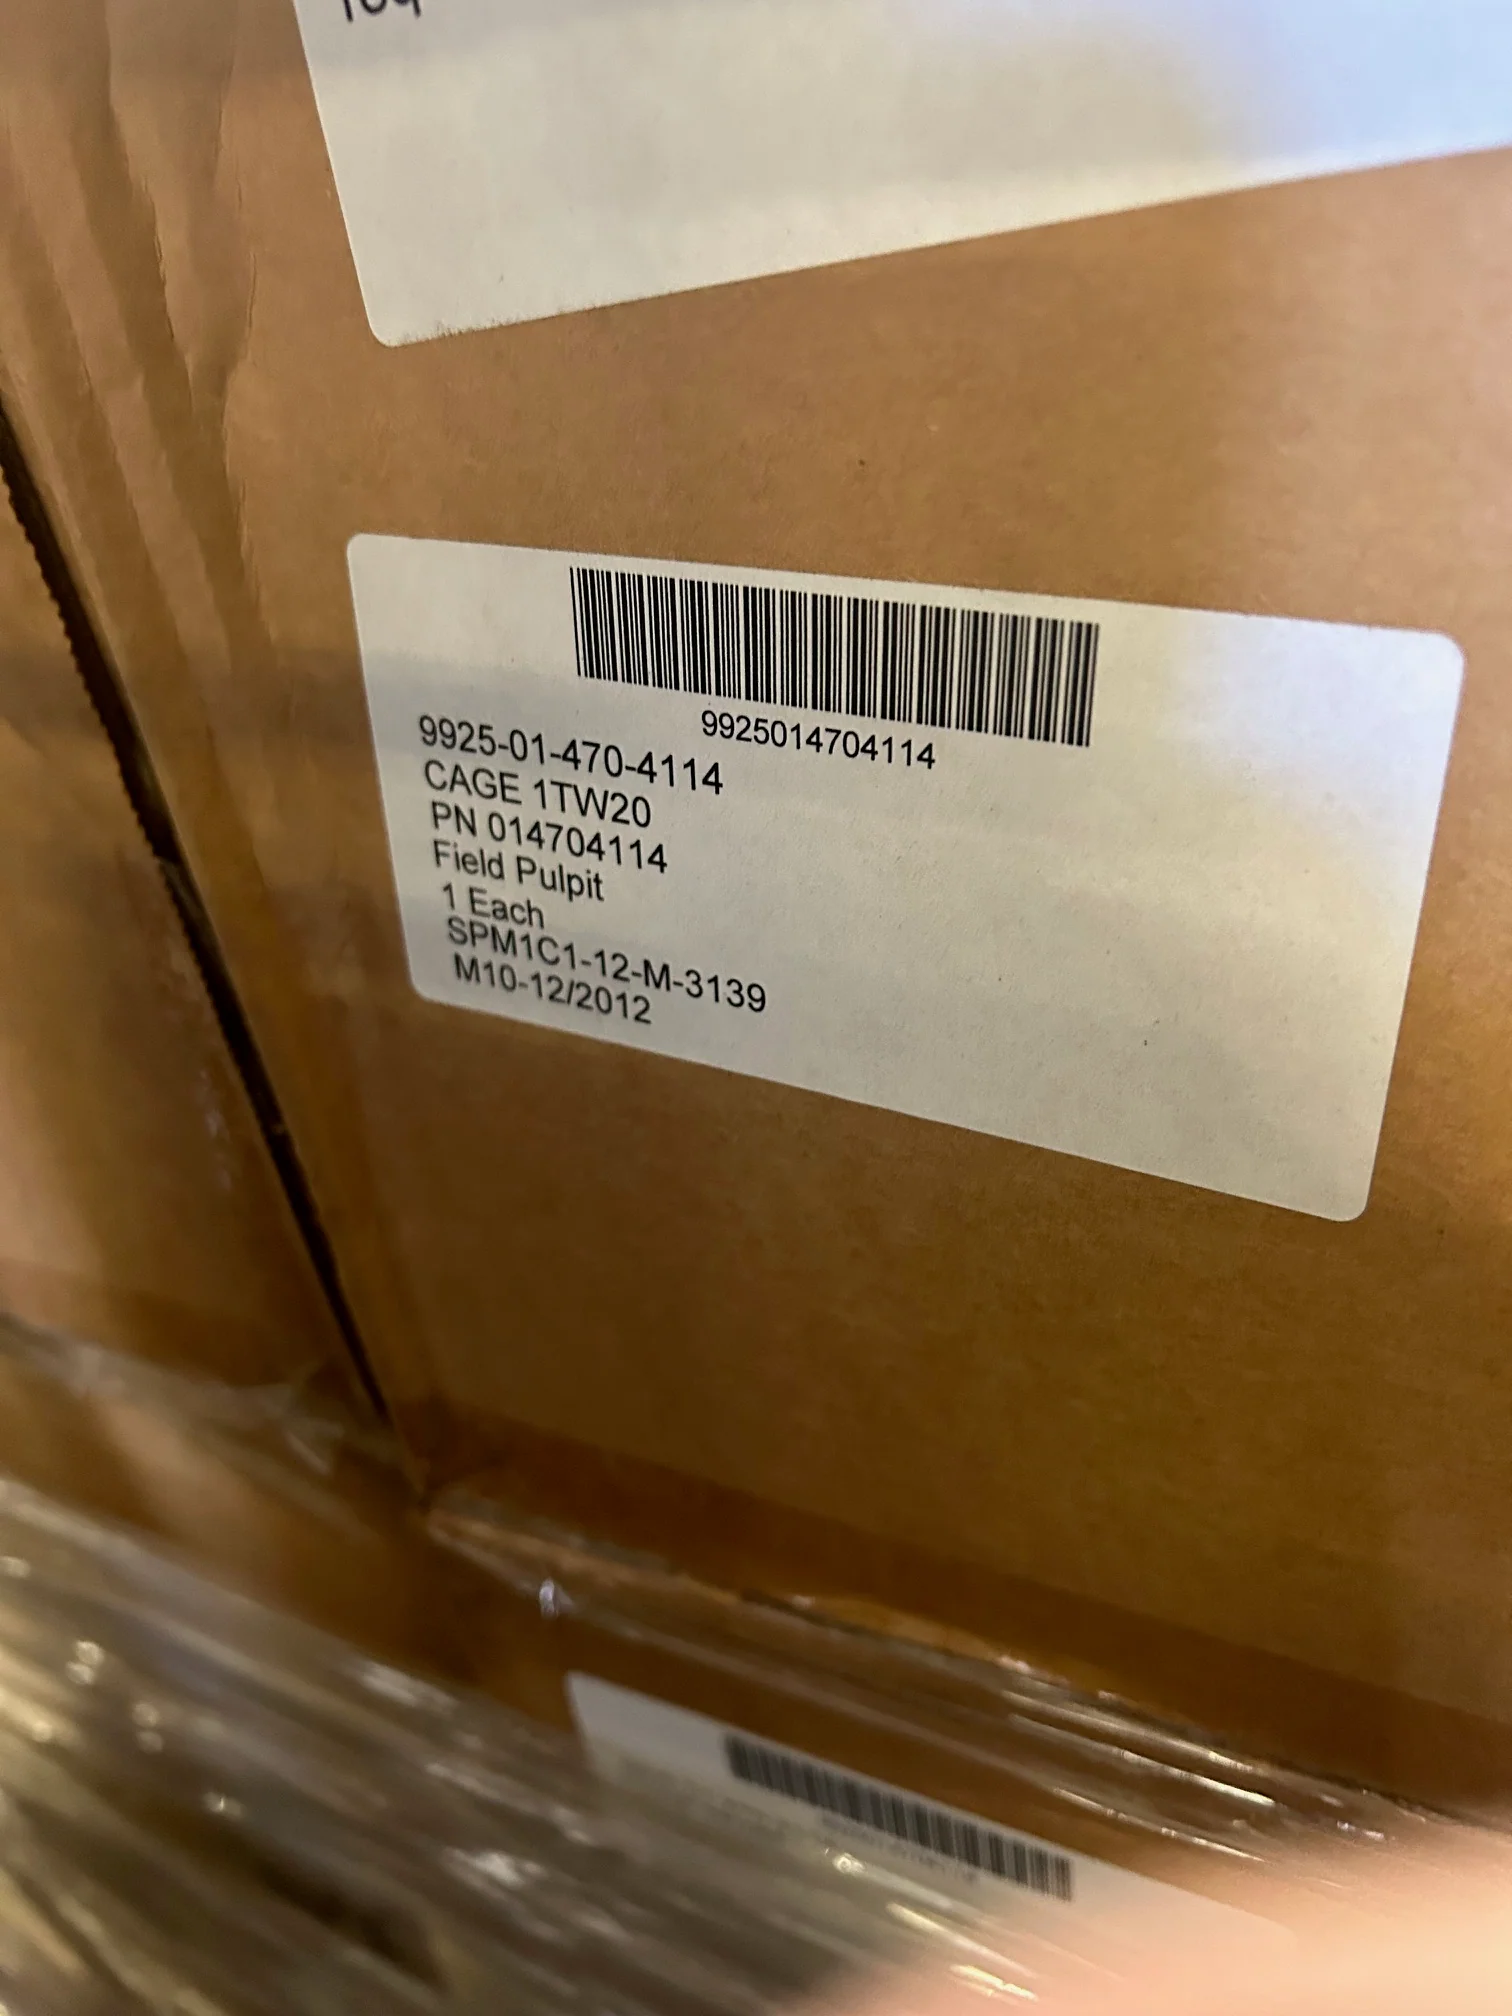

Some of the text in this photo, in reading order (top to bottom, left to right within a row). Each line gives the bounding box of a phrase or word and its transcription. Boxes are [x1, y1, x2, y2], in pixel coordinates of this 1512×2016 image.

[419, 714, 724, 795] 9925-01-470-4114
[701, 710, 936, 770] 9925014704114
[424, 759, 652, 828] CAGE 1TW20
[431, 800, 668, 874] PN 014704114
[433, 840, 605, 902] Field Pulpit
[442, 883, 545, 930] 1 Each
[447, 917, 767, 1013] SPM1C1-12-M-3139
[454, 953, 652, 1025] M10-12/2012
